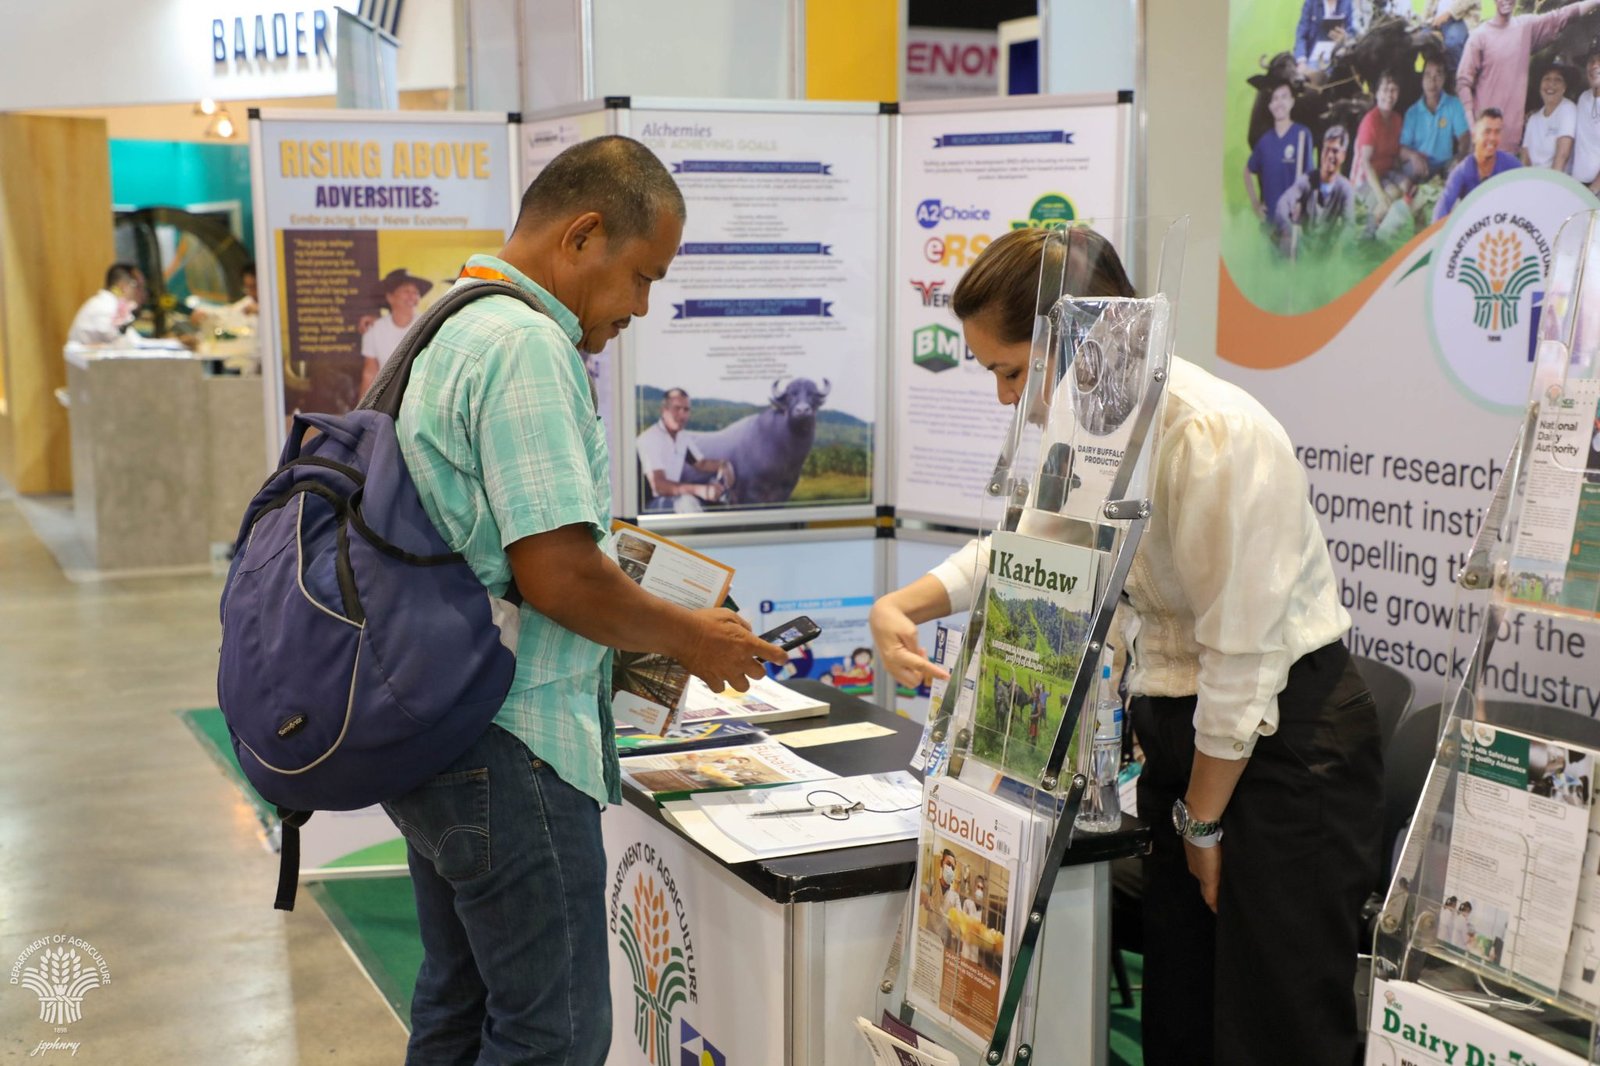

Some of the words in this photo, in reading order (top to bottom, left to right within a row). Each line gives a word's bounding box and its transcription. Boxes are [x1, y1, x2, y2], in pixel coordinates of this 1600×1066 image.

[212, 9, 331, 61] BAADER
[642, 123, 713, 138] Alchemies
[736, 140, 779, 151] GOALS
[279, 139, 382, 178] RISING
[392, 141, 492, 180] ABOVE
[315, 185, 440, 208] ADVERSITIES:
[941, 205, 990, 220] Choice
[289, 214, 356, 227] Embracing
[358, 214, 380, 225] the
[383, 215, 410, 225] New
[414, 215, 469, 227] Economy
[1446, 216, 1491, 279] DEPARTMENT
[1494, 213, 1508, 224] OF
[1539, 420, 1578, 431] Natonal
[1077, 445, 1096, 455] DAIRY
[1084, 455, 1121, 467] PRODUCTIO
[1296, 444, 1375, 475] remier
[1383, 455, 1503, 492] research
[998, 551, 1079, 594] Karbaw
[1326, 538, 1436, 586] ropelling
[1386, 594, 1482, 634] growth
[1534, 617, 1586, 659] the
[1348, 626, 1467, 679] livestock
[1483, 661, 1600, 717] ndustry
[926, 799, 997, 851] Bubalus
[609, 842, 643, 935] DEPARTMENT
[644, 843, 656, 864] OF
[656, 857, 699, 1004] AGRICULTURE
[1382, 1007, 1459, 1066] Dairy
